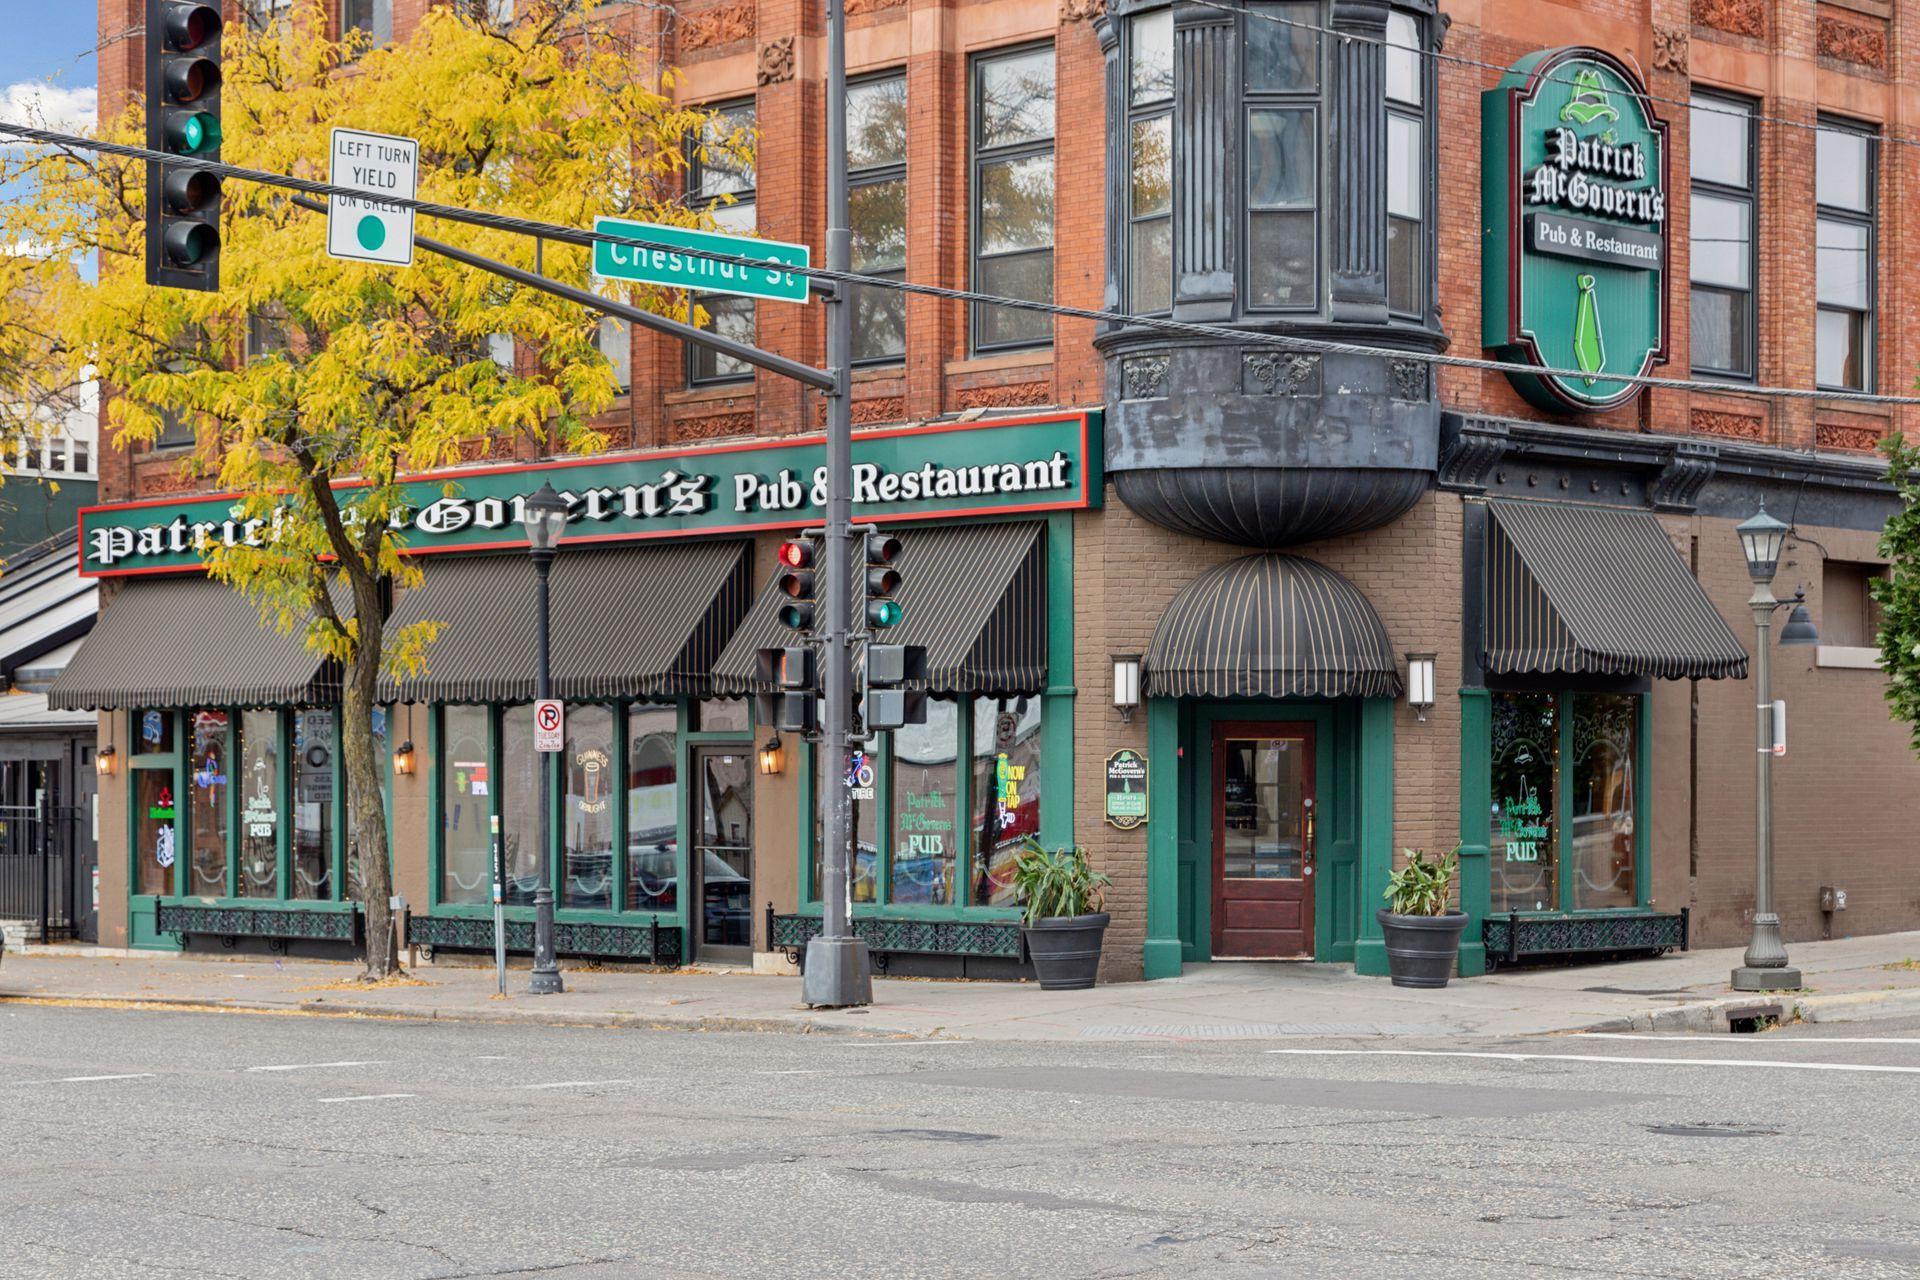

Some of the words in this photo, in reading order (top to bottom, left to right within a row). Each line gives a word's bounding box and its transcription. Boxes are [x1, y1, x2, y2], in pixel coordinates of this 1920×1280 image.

[339, 140, 372, 159] LEFT
[378, 145, 411, 165] TURN
[1554, 127, 1646, 179] Patrick
[353, 166, 397, 189] YIELD
[339, 194, 357, 208] ON
[1530, 164, 1665, 222] McGovern's
[1540, 221, 1567, 245] Pub
[1570, 227, 1583, 248] &
[1585, 230, 1659, 261] Restaurant
[610, 240, 749, 281] Chestnut
[765, 255, 795, 288] St
[733, 468, 803, 513] Pub
[851, 450, 1069, 504] Restaurant
[576, 749, 609, 768] GUINNESS
[1007, 765, 1025, 781] NOW
[1006, 780, 1017, 795] ON
[1007, 794, 1020, 809] TAP
[908, 834, 944, 854] PUB
[1506, 841, 1539, 862] PUB
